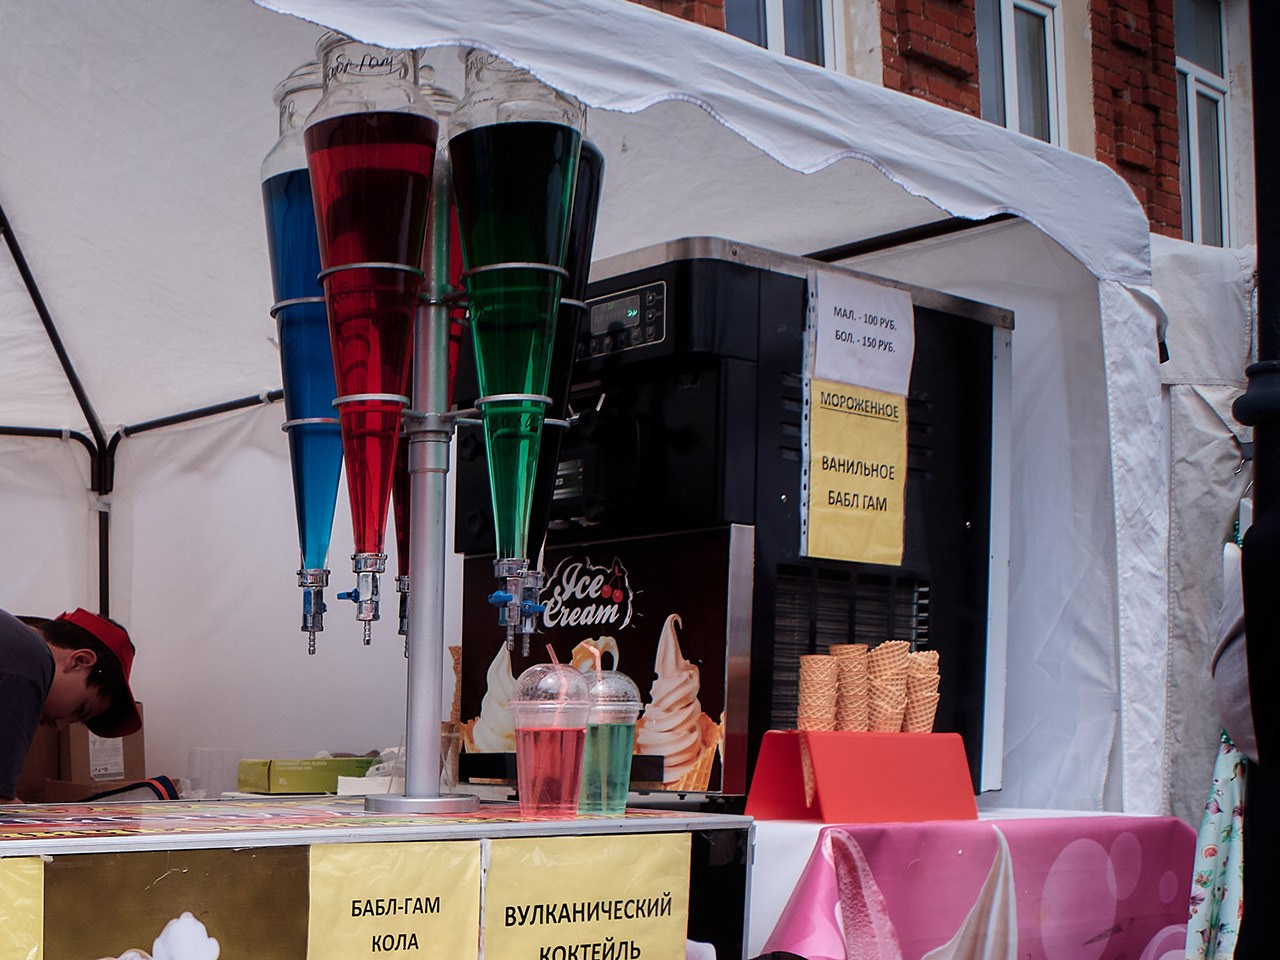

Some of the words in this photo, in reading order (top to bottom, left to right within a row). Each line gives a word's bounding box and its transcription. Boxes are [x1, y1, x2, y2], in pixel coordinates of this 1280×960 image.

[833, 306, 857, 322] МАЛ.
[864, 313, 878, 327] 100
[880, 316, 898, 331] РУБ.
[835, 329, 855, 344] БОЛ.
[862, 336, 877, 349] 150
[879, 339, 896, 353] РУБ.
[820, 391, 899, 419] МОРОЖЕННОЕ
[822, 455, 895, 480] ВАНИЛЬНОЕ
[828, 490, 860, 509] БАБЛ
[863, 495, 887, 512] ГАМ
[561, 563, 604, 601] Ice
[542, 585, 620, 628] Cream
[351, 896, 441, 918] БАБЛ-ГАМ
[504, 891, 673, 928] ВУЛКАНИЧЕСКИЙ
[371, 933, 419, 953] КОЛА
